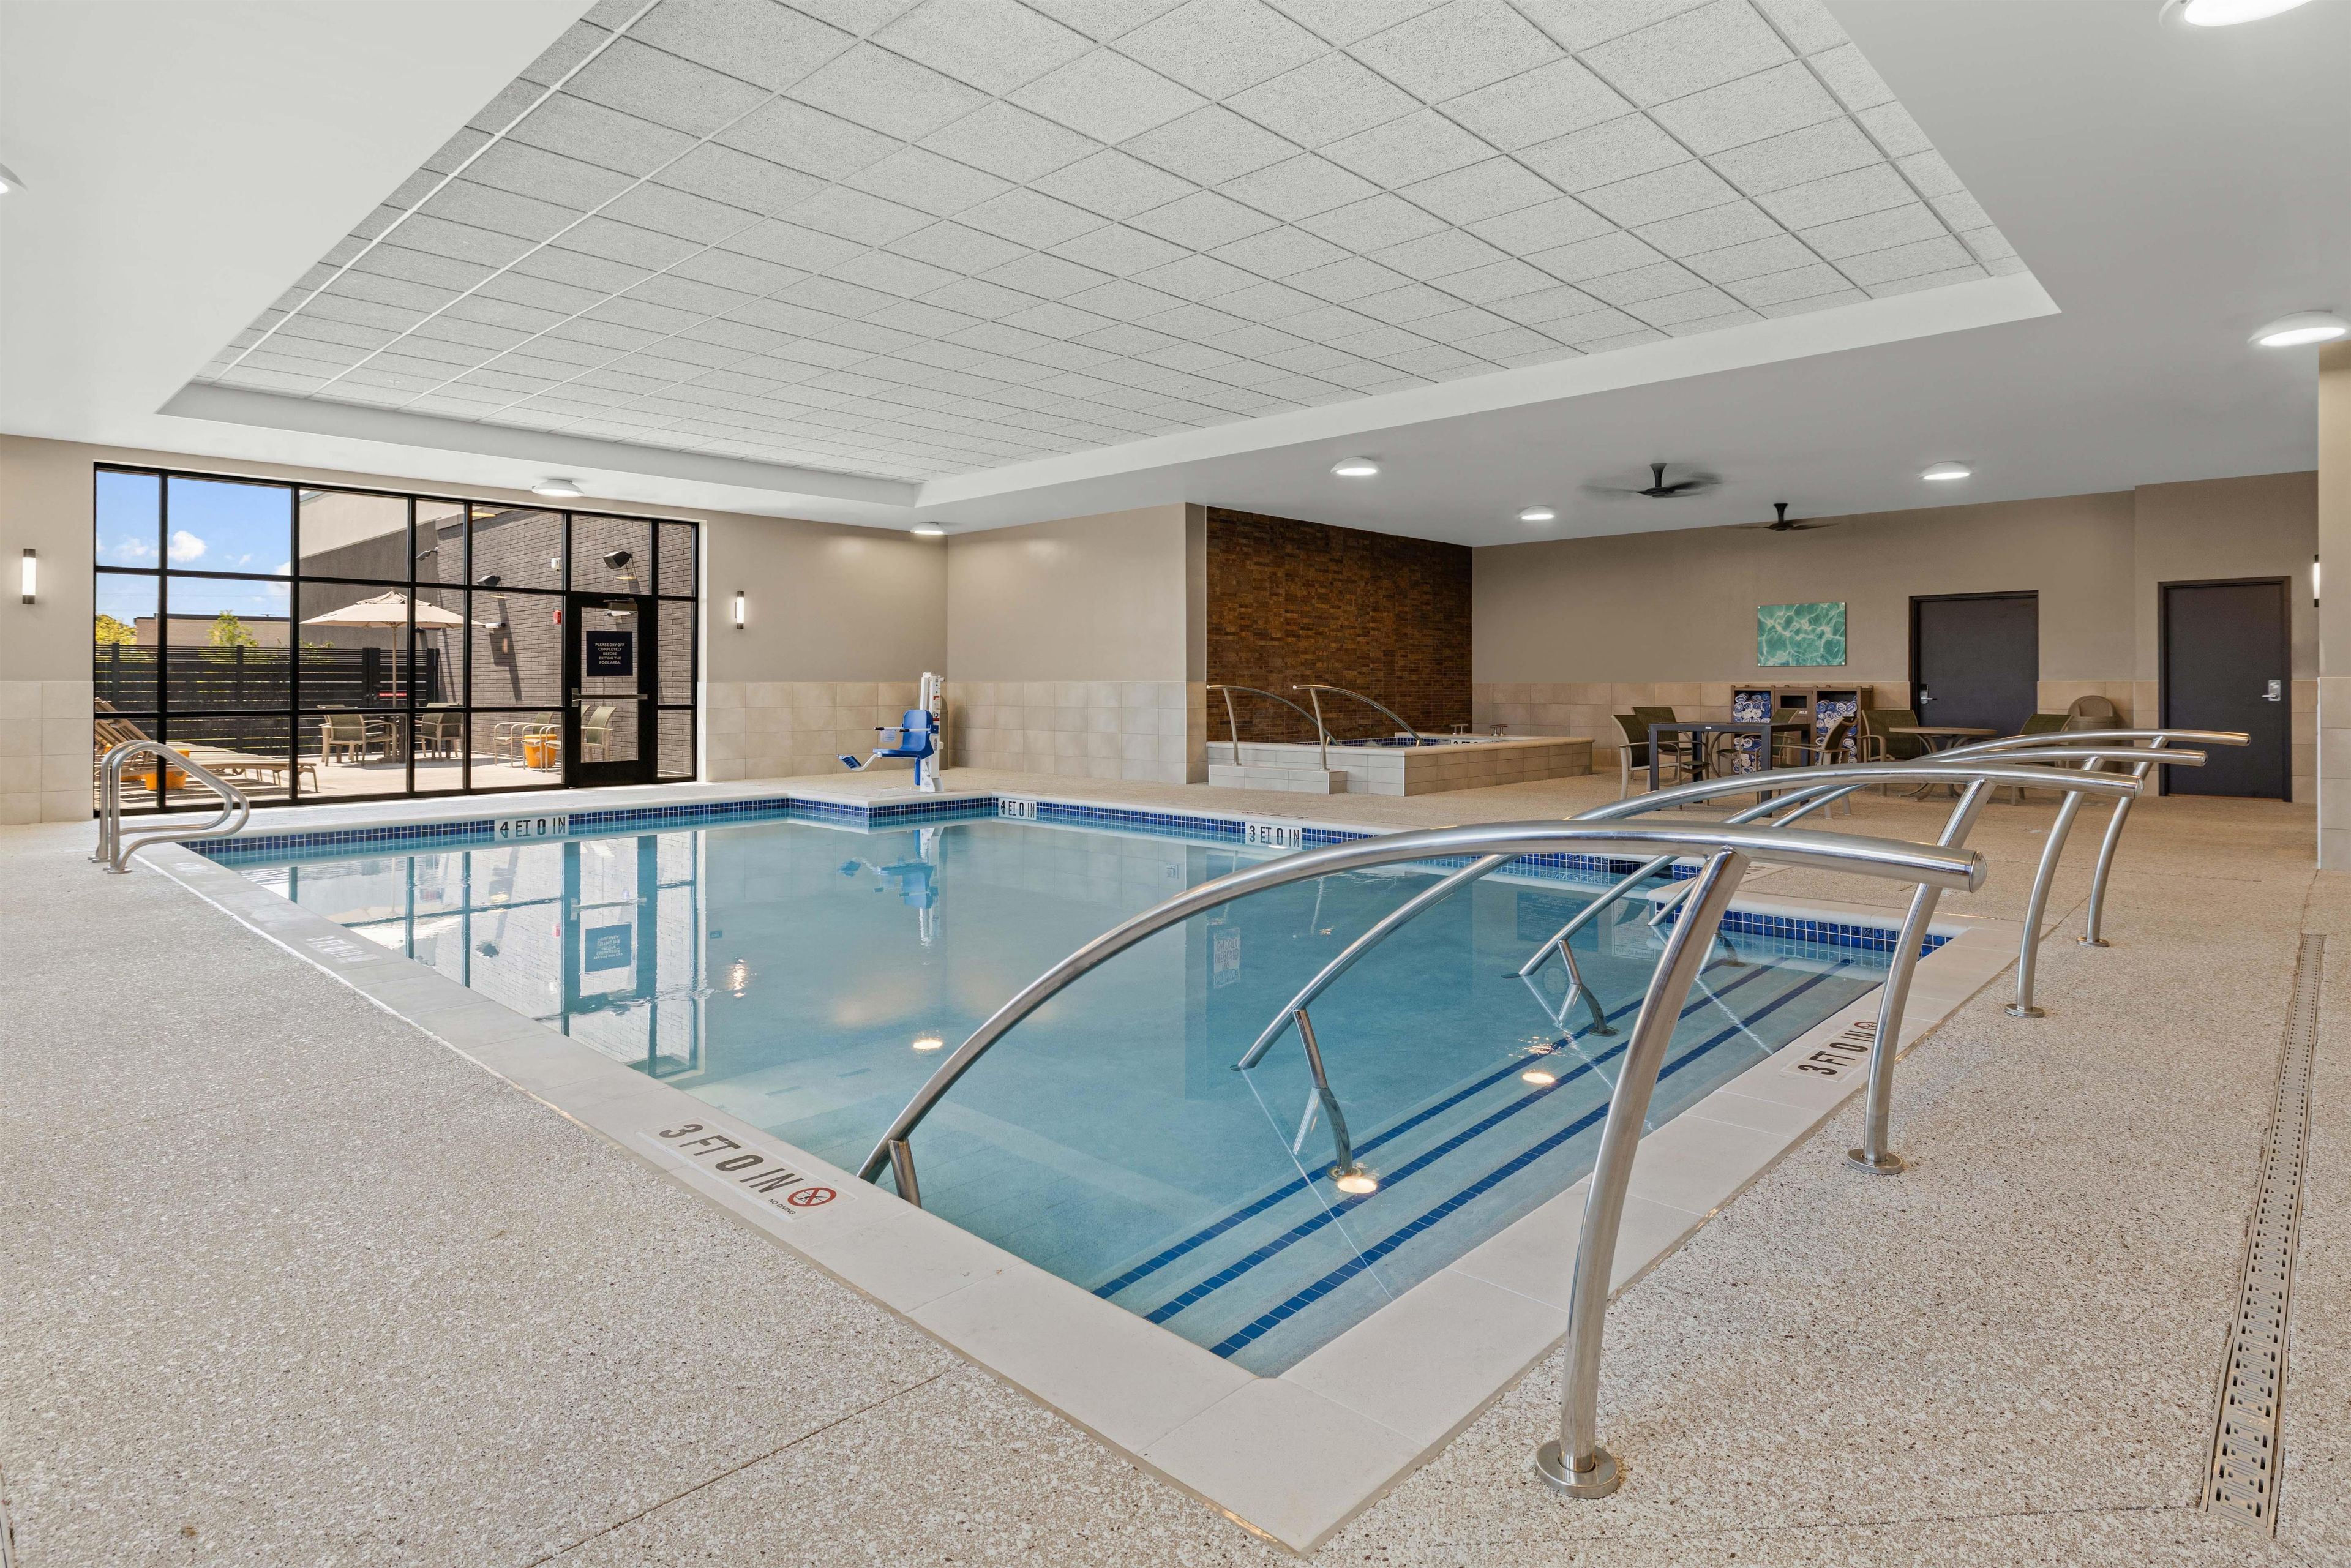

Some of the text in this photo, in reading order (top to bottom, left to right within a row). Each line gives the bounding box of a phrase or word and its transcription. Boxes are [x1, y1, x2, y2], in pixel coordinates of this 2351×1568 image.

[1001, 800, 1005, 809] 4
[1027, 803, 1035, 811] IN
[500, 821, 509, 831] 4
[553, 817, 566, 827] IN
[1249, 825, 1255, 835] 3
[1289, 829, 1299, 839] IN
[1798, 1030, 1875, 1075] 3 FT 0 IN
[659, 1124, 804, 1193] 3 FT 0 IN
[768, 1198, 796, 1215] NO DIVING
